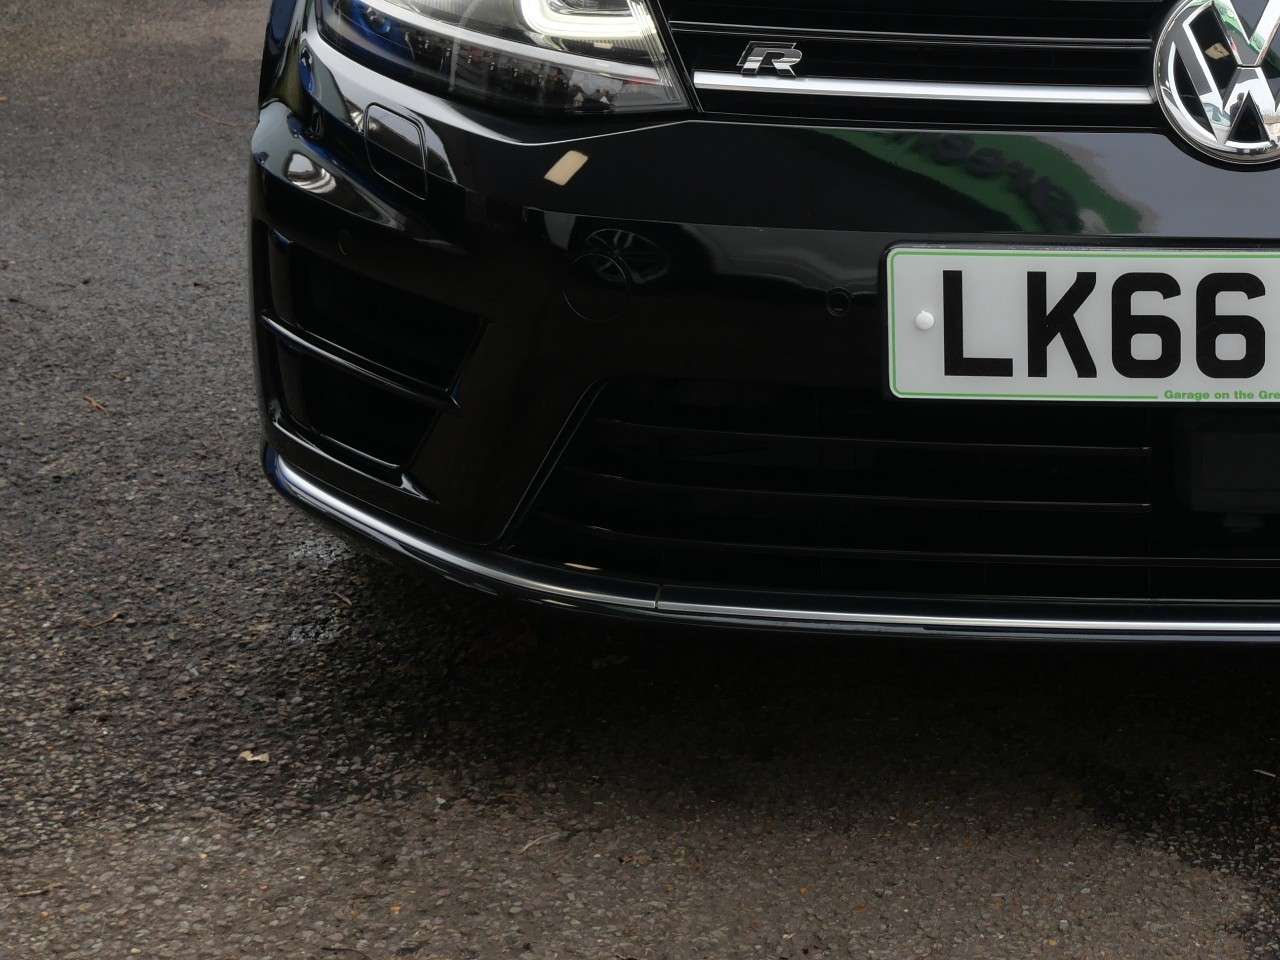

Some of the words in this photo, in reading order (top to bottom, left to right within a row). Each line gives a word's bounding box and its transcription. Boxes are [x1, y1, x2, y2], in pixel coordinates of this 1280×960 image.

[942, 270, 1266, 379] LK66
[1163, 390, 1210, 402] Garage
[1214, 391, 1230, 400] on
[1234, 390, 1252, 400] the
